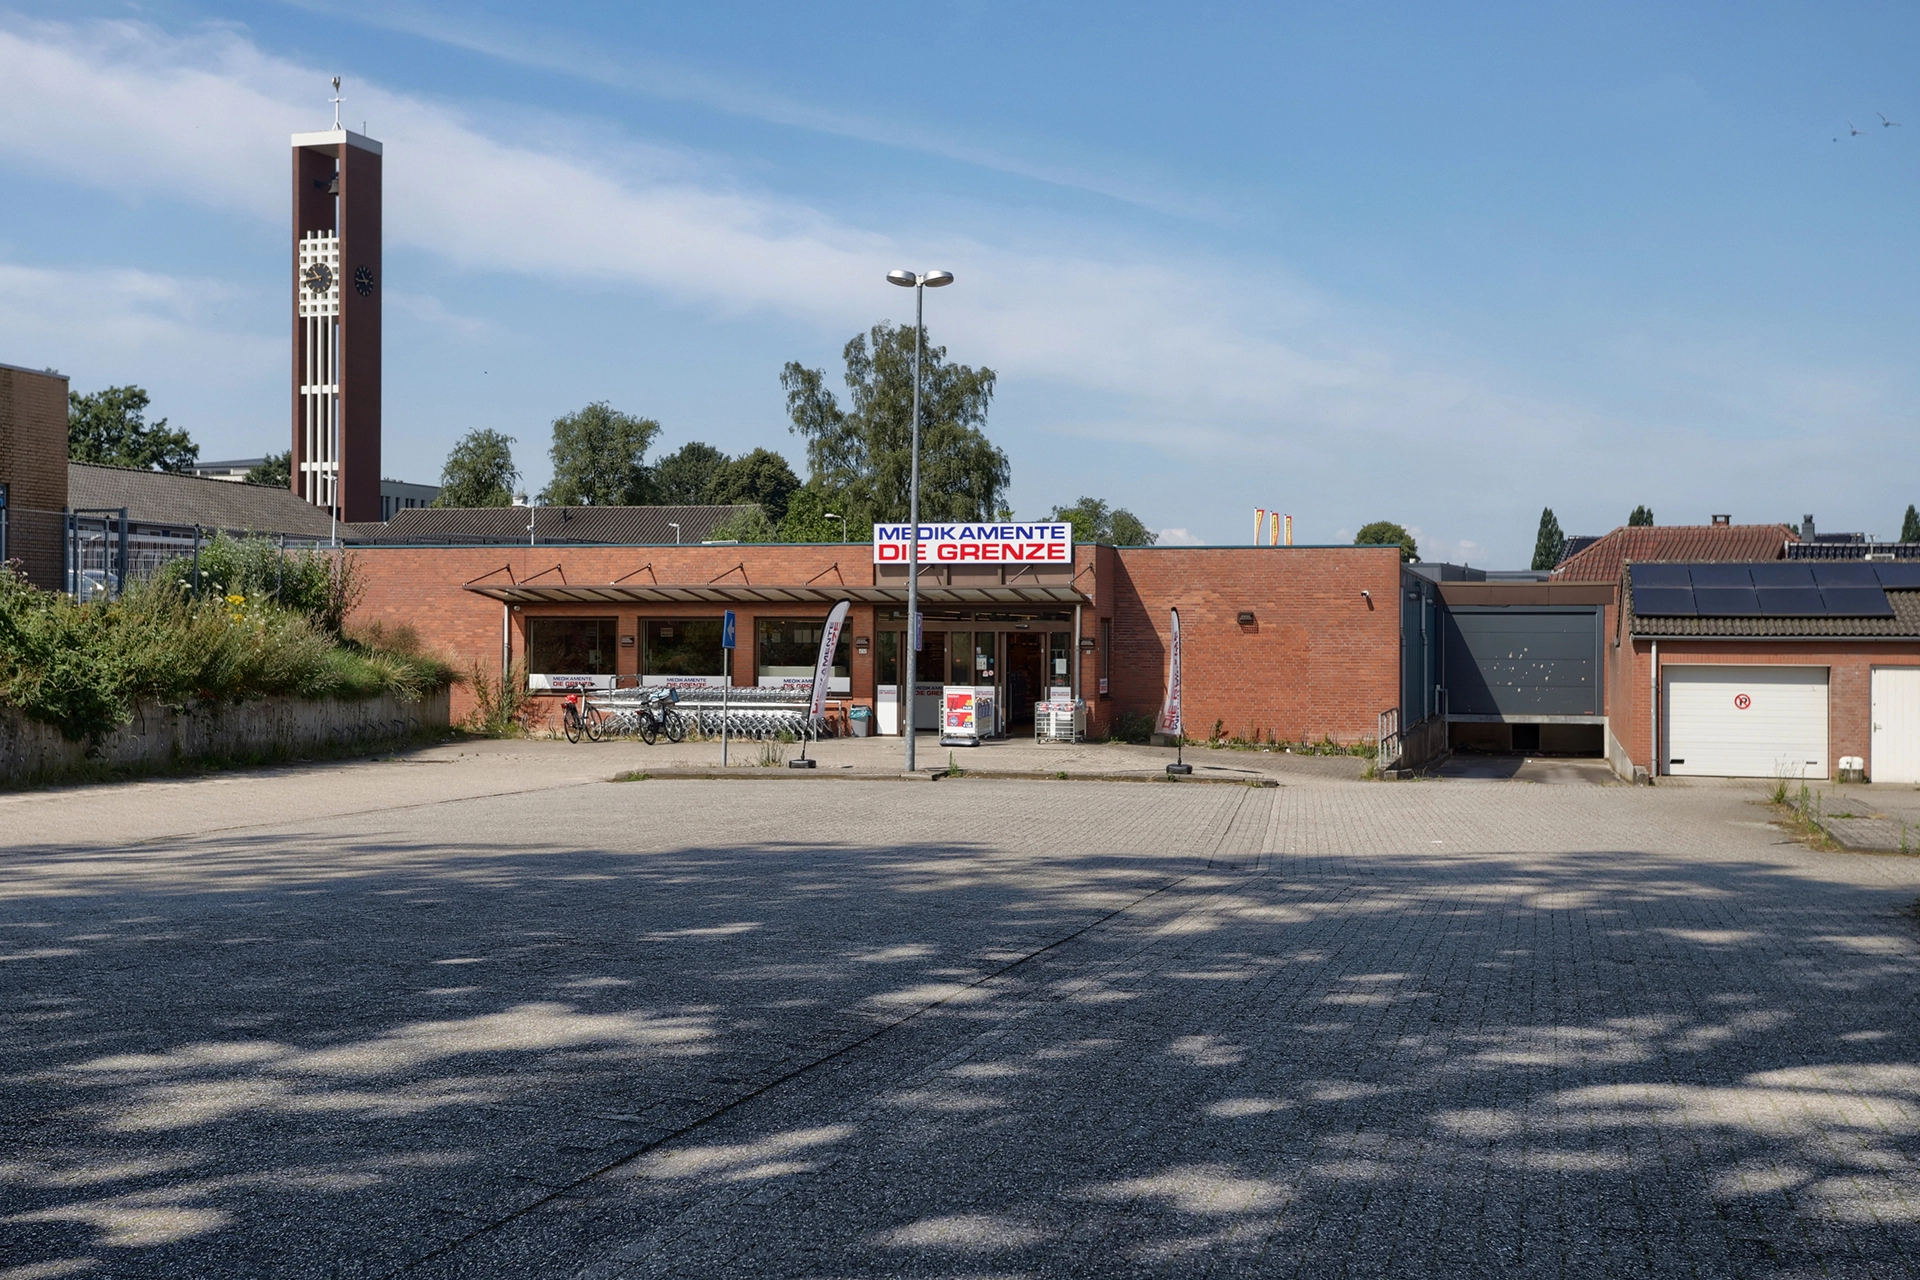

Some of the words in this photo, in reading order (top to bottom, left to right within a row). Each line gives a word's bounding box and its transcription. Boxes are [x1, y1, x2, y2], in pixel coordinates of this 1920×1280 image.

[878, 526, 1066, 541] MEDIKAMENTE
[878, 544, 927, 561] DIE
[937, 543, 1066, 561] GRENZE
